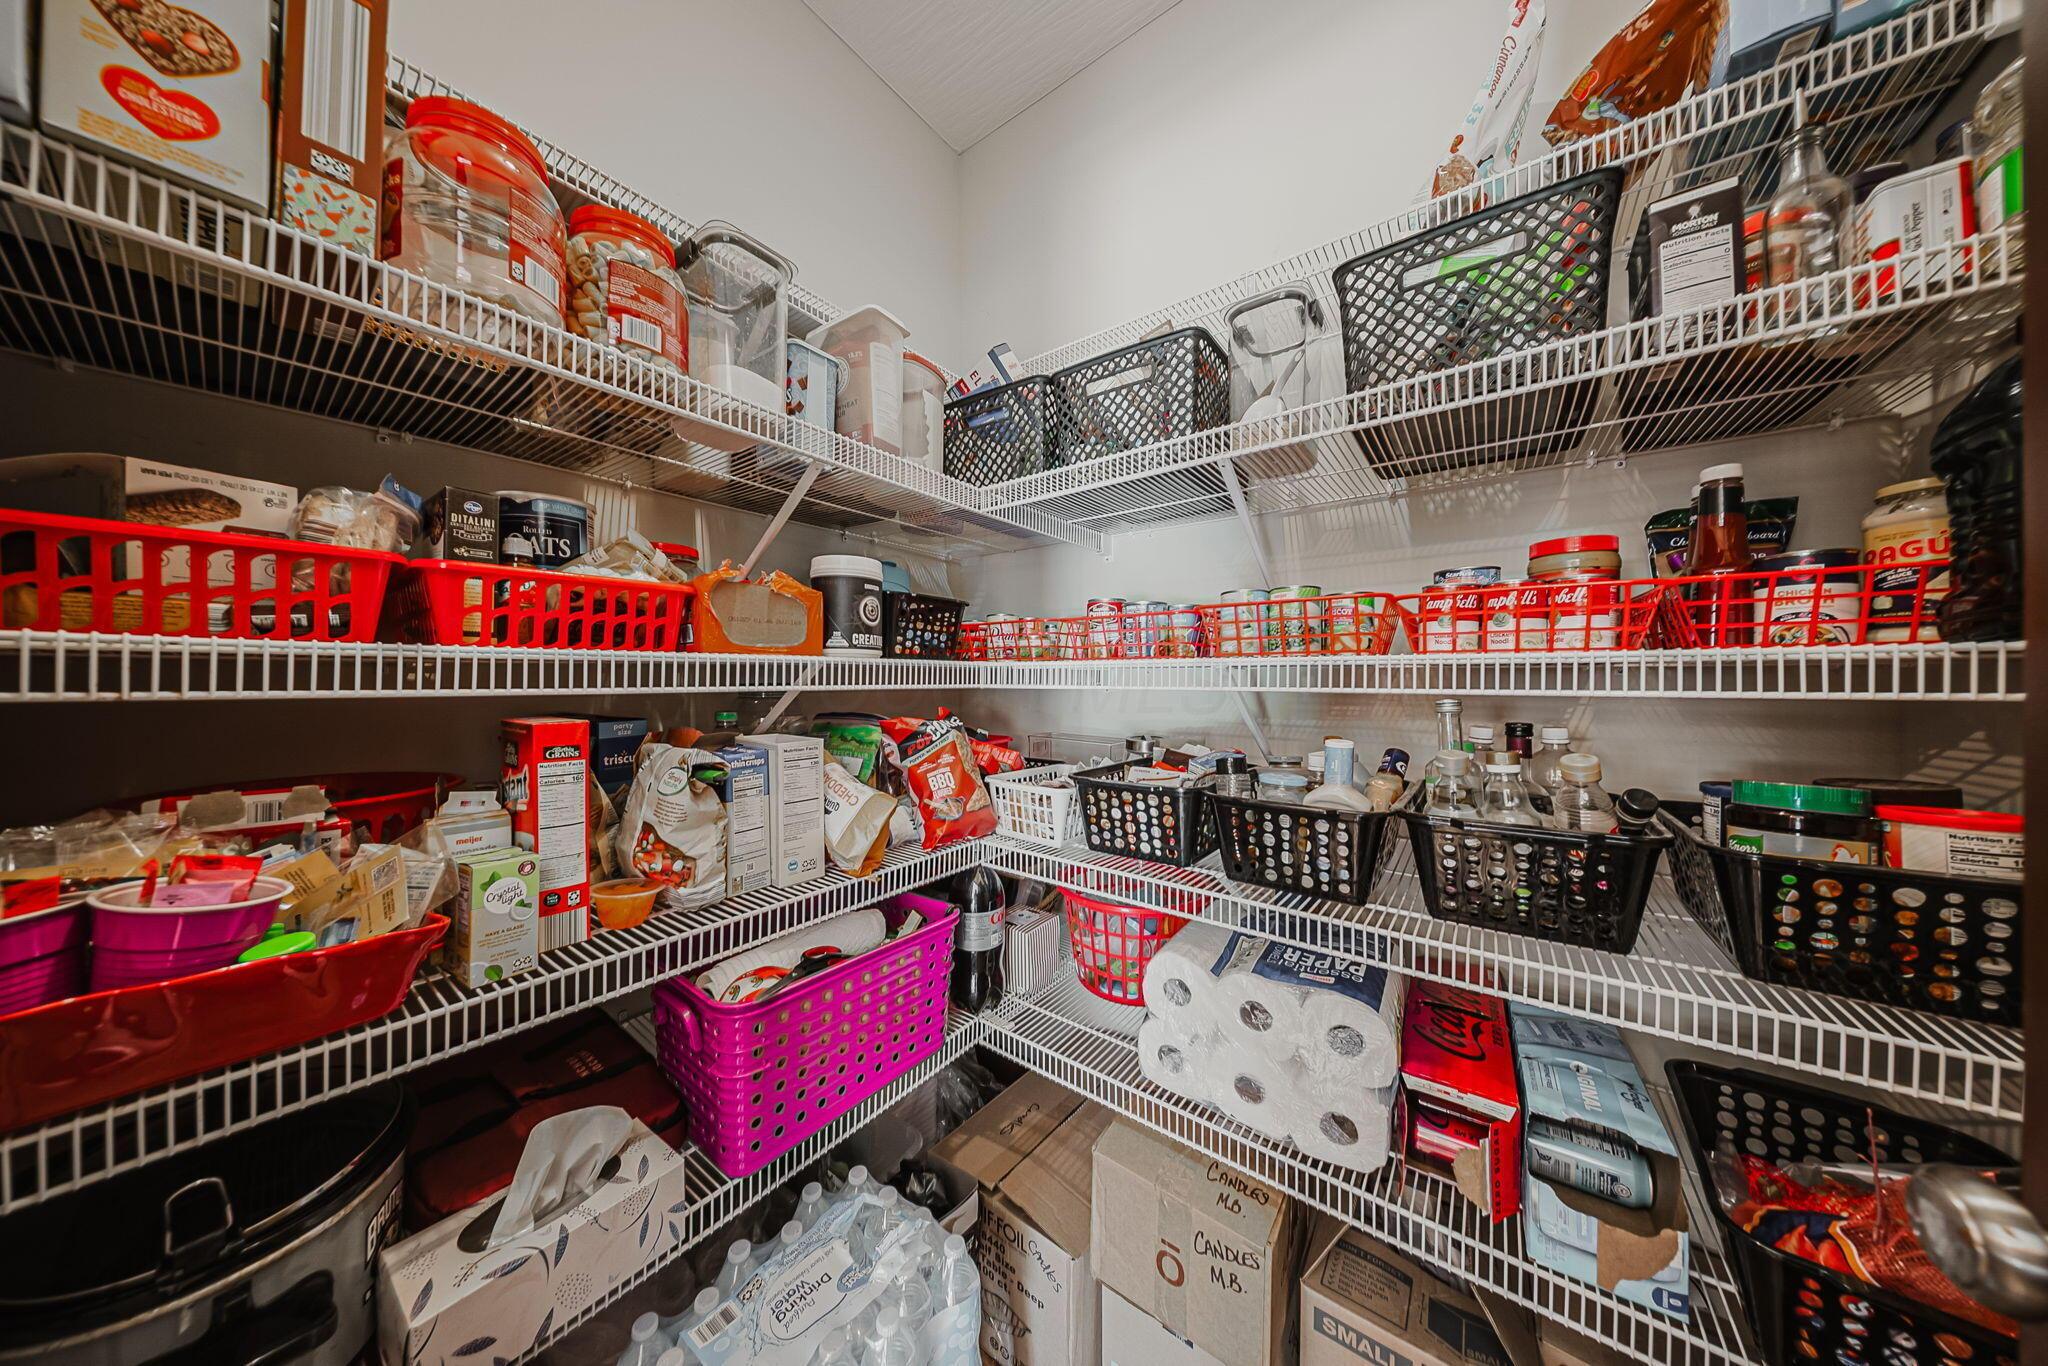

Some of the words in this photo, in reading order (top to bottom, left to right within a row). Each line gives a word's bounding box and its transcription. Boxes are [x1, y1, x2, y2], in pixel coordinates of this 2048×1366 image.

[1488, 36, 1517, 98] Cinnamon
[1671, 212, 1719, 233] MORTON
[1662, 235, 1702, 250] Nutrition
[1705, 227, 1730, 237] Facts
[140, 467, 157, 475] BAR
[158, 469, 172, 478] PER
[451, 512, 496, 528] DITALINI
[613, 723, 634, 731] party
[603, 755, 634, 766] triscu
[928, 771, 956, 791] BBQ
[455, 834, 483, 846] meijer
[1728, 839, 1761, 854] Knorr
[1949, 833, 2003, 844] Nutrition
[1950, 855, 1999, 866] Calories
[486, 881, 520, 904] Crystal
[485, 930, 501, 938] HAVE
[1279, 959, 1363, 983] essential
[1283, 947, 1367, 977] PAPER
[1207, 1161, 1270, 1206] CANDLES
[1216, 1192, 1247, 1218] M.B.
[1194, 1231, 1260, 1270] CANDLES
[1210, 1265, 1248, 1294] M.B.
[770, 1279, 810, 1316] Water
[775, 1272, 833, 1323] Drinking
[1016, 1281, 1045, 1309] Deep
